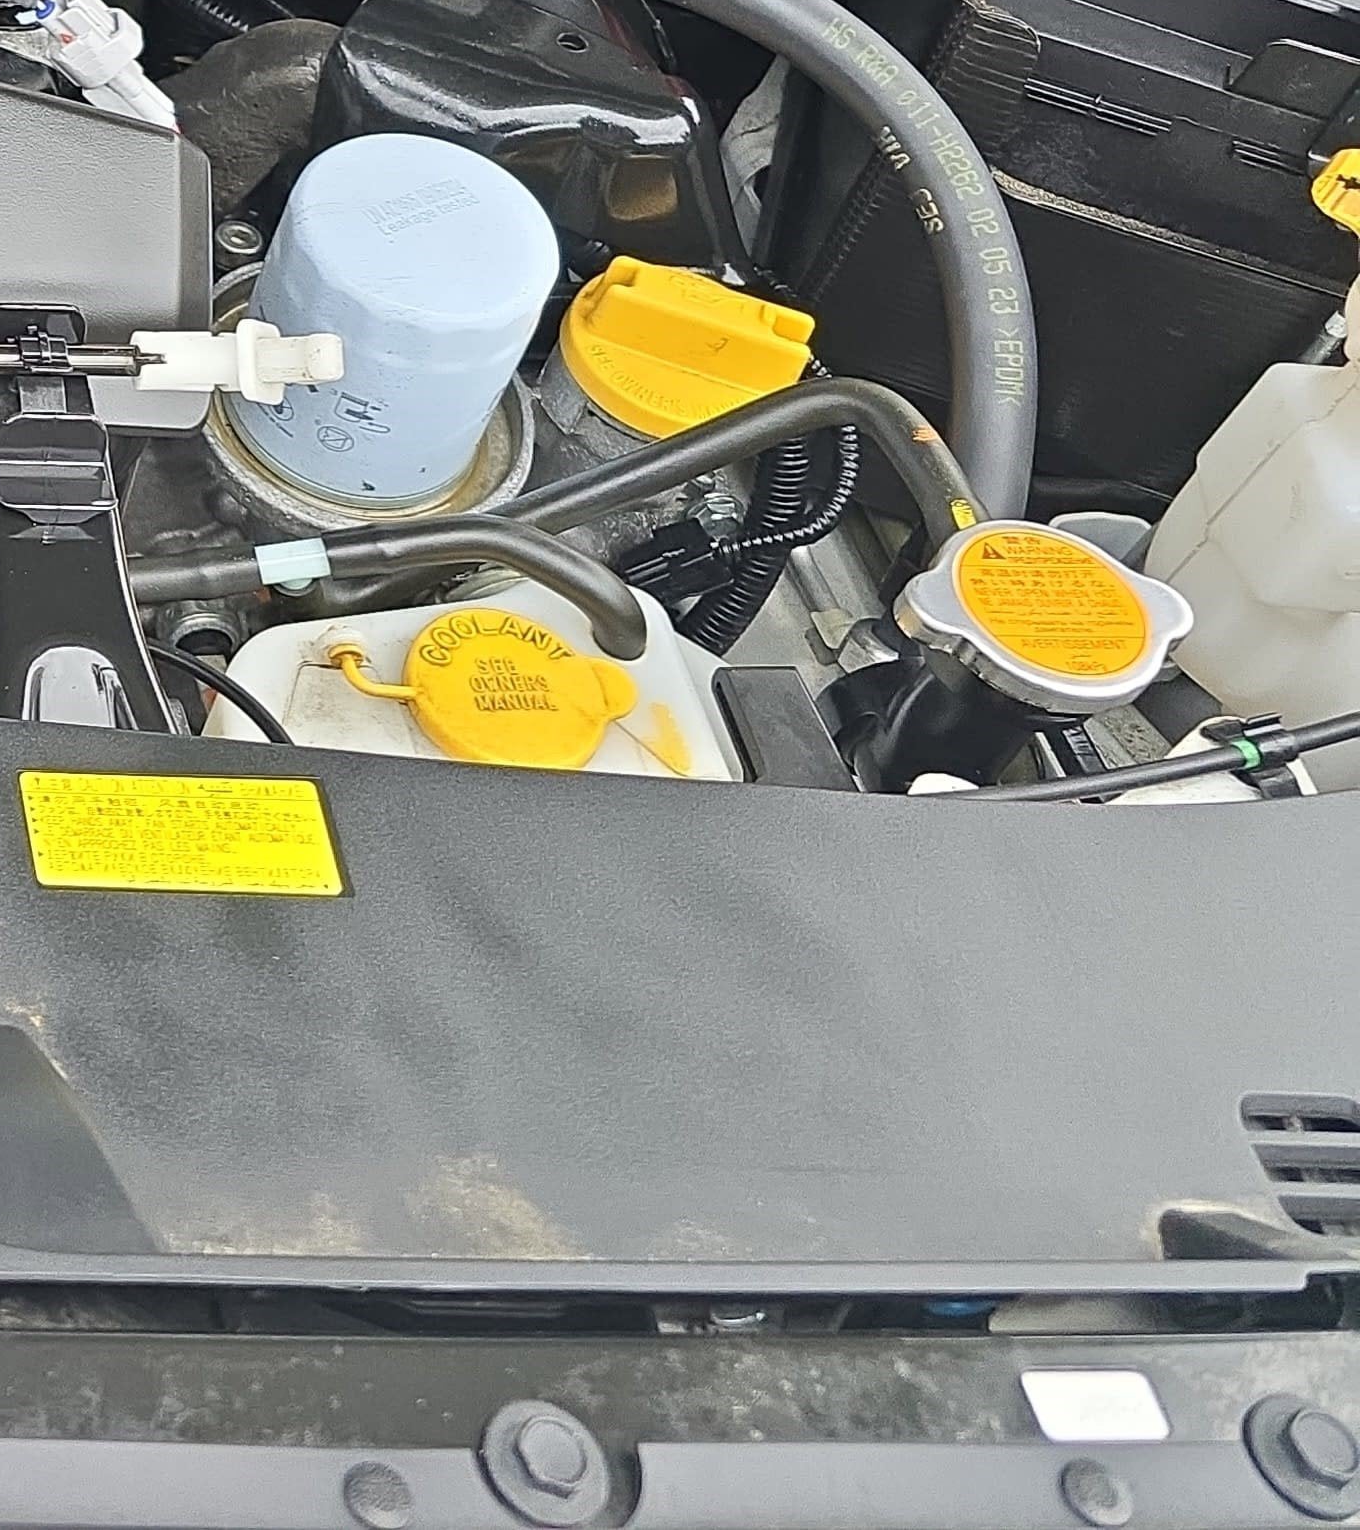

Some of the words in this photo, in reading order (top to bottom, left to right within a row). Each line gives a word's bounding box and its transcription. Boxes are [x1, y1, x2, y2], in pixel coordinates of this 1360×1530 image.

[1004, 545, 1074, 557] WARNING
[418, 612, 576, 667] COOLANT
[475, 657, 521, 676] SEE
[473, 692, 560, 712] MANUAL
